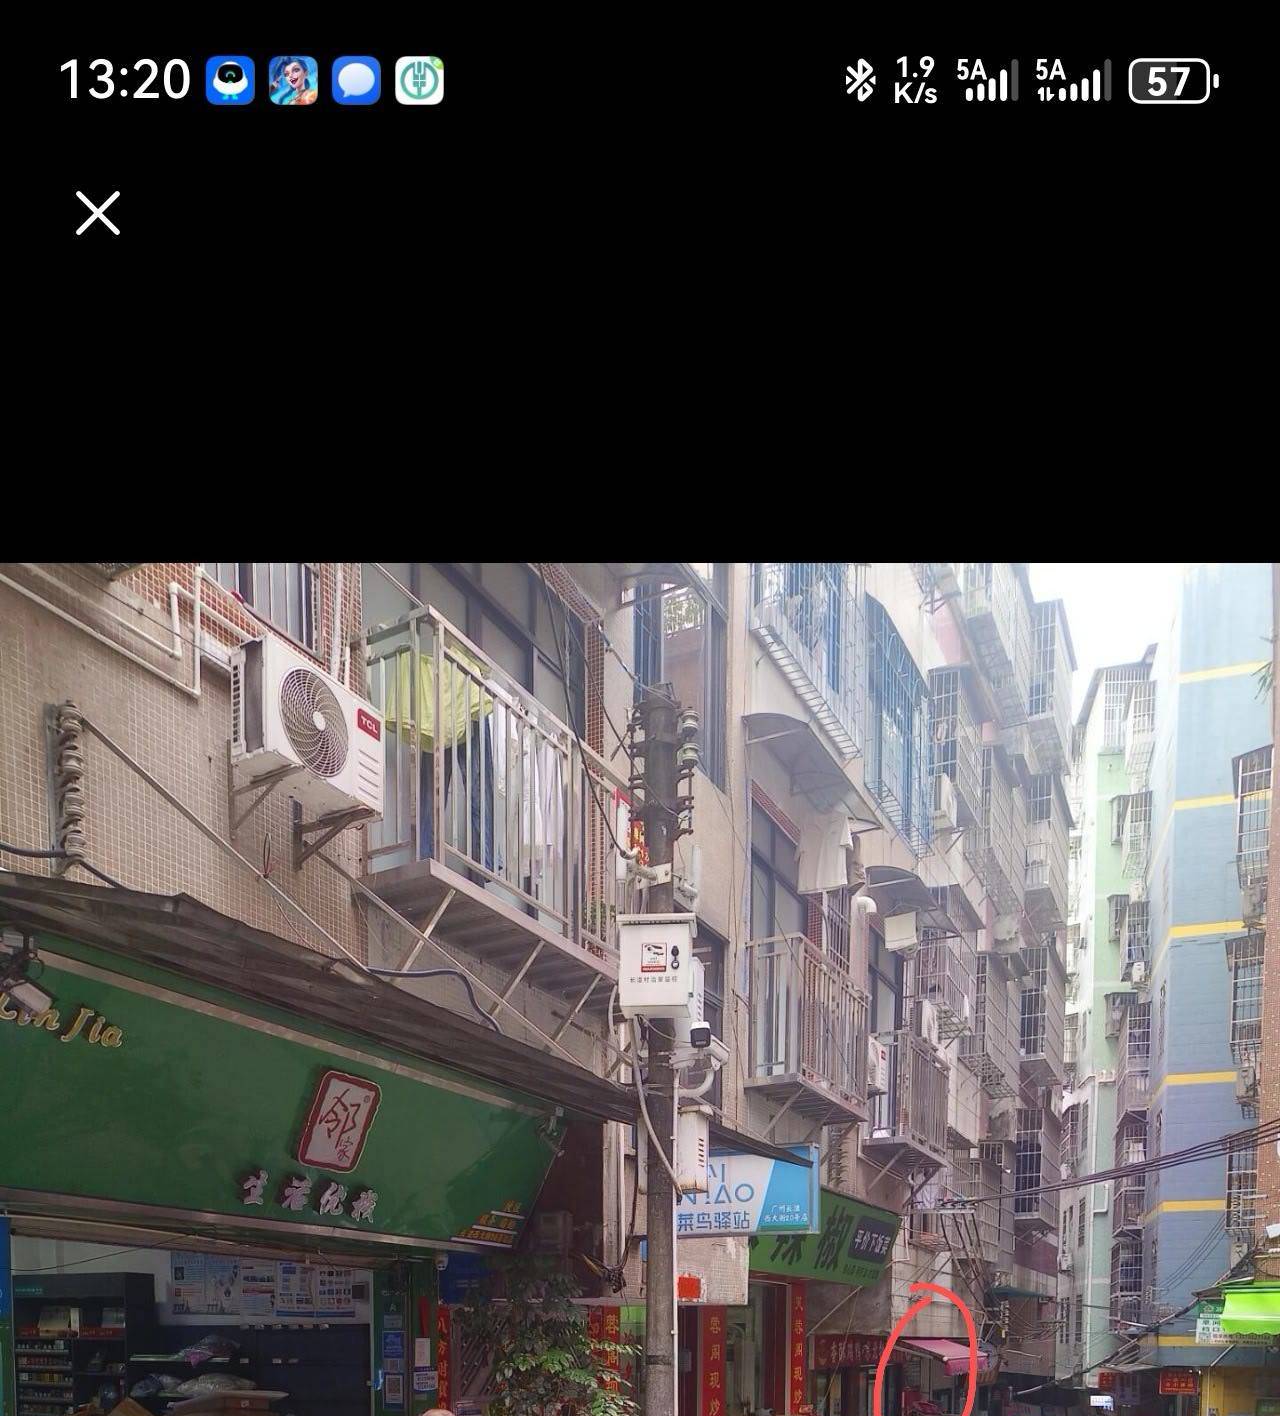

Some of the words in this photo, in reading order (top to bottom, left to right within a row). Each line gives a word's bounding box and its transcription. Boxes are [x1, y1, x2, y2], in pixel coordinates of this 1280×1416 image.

[360, 715, 378, 734] TCL
[61, 1007, 123, 1047] Jia
[677, 1210, 750, 1232] 菜鸟驿站
